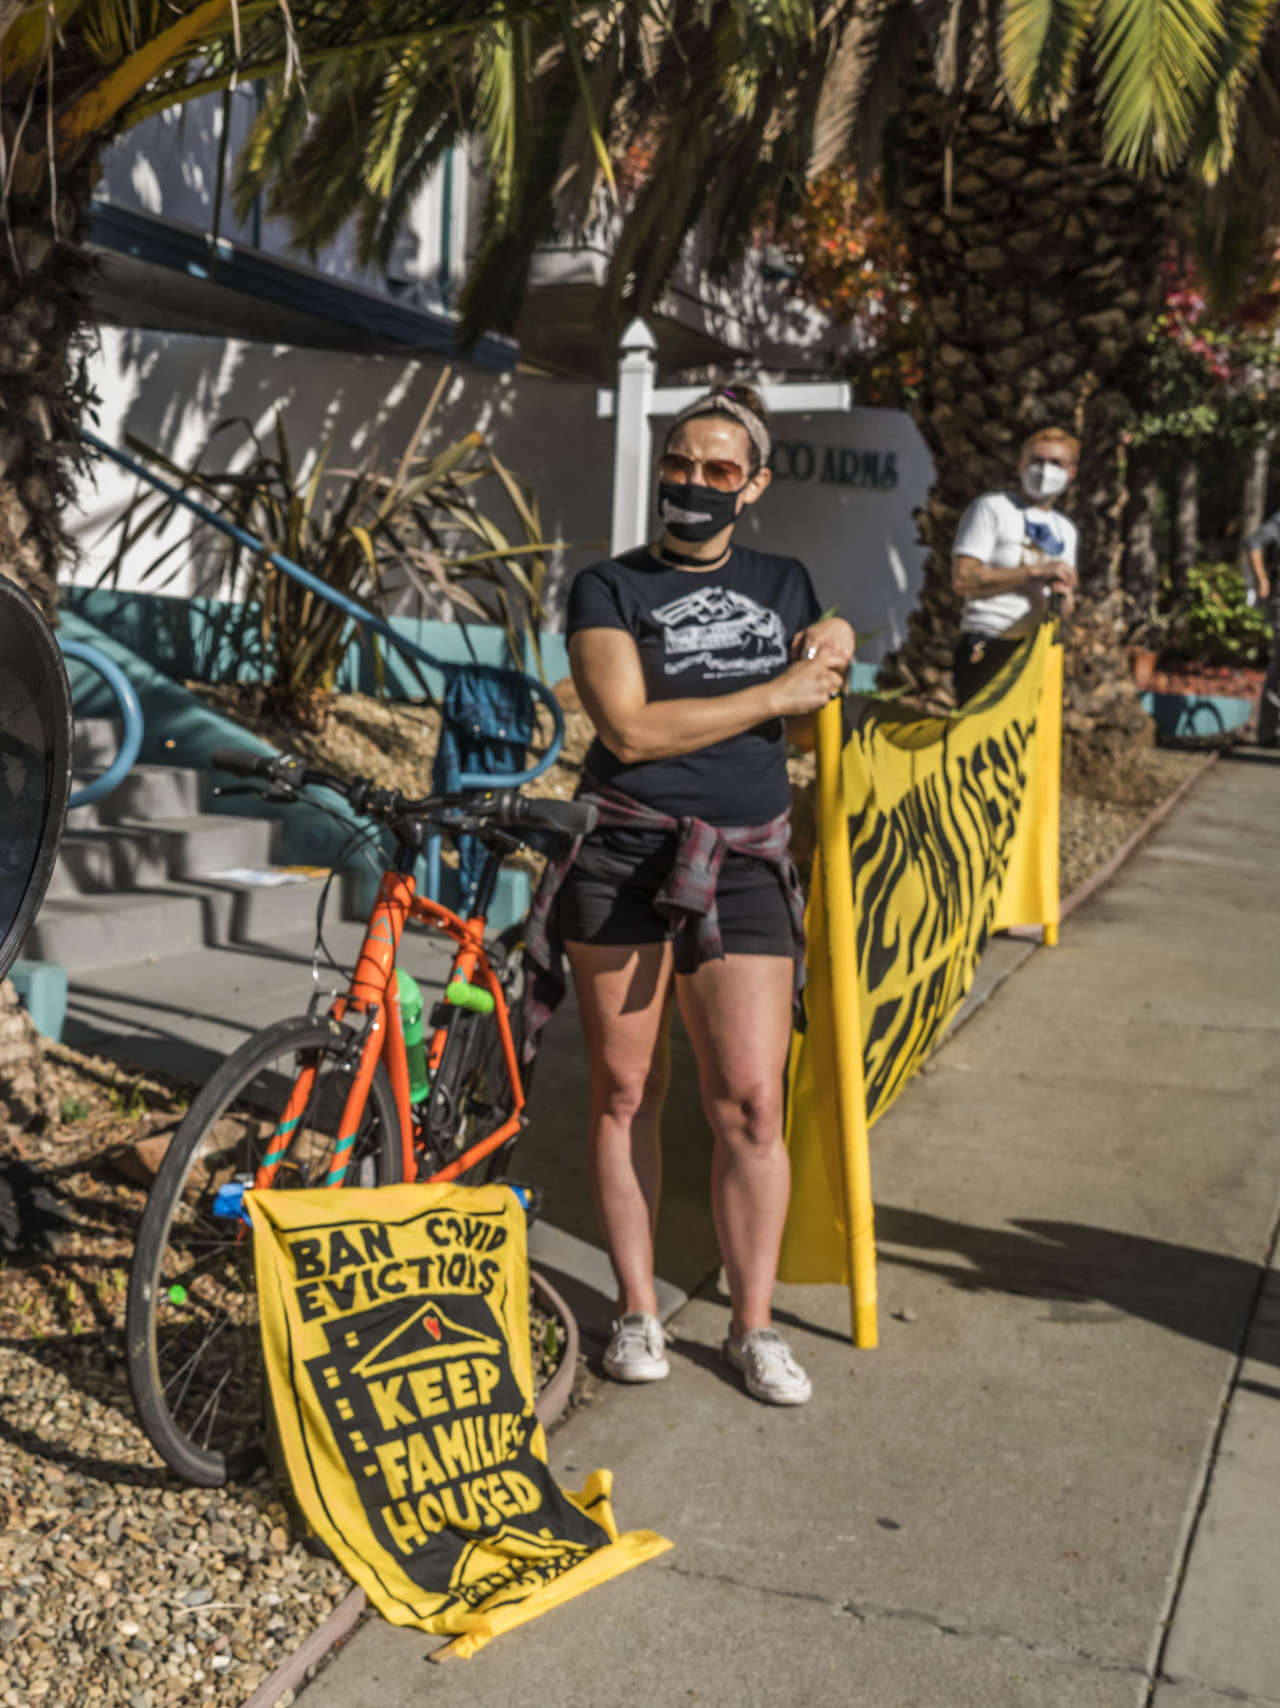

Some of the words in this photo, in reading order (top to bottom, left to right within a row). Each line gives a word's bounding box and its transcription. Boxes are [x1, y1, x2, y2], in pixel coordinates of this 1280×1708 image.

[289, 1224, 394, 1281] BAN
[366, 1358, 501, 1431] KEEP
[380, 1470, 542, 1556] HOUSED
